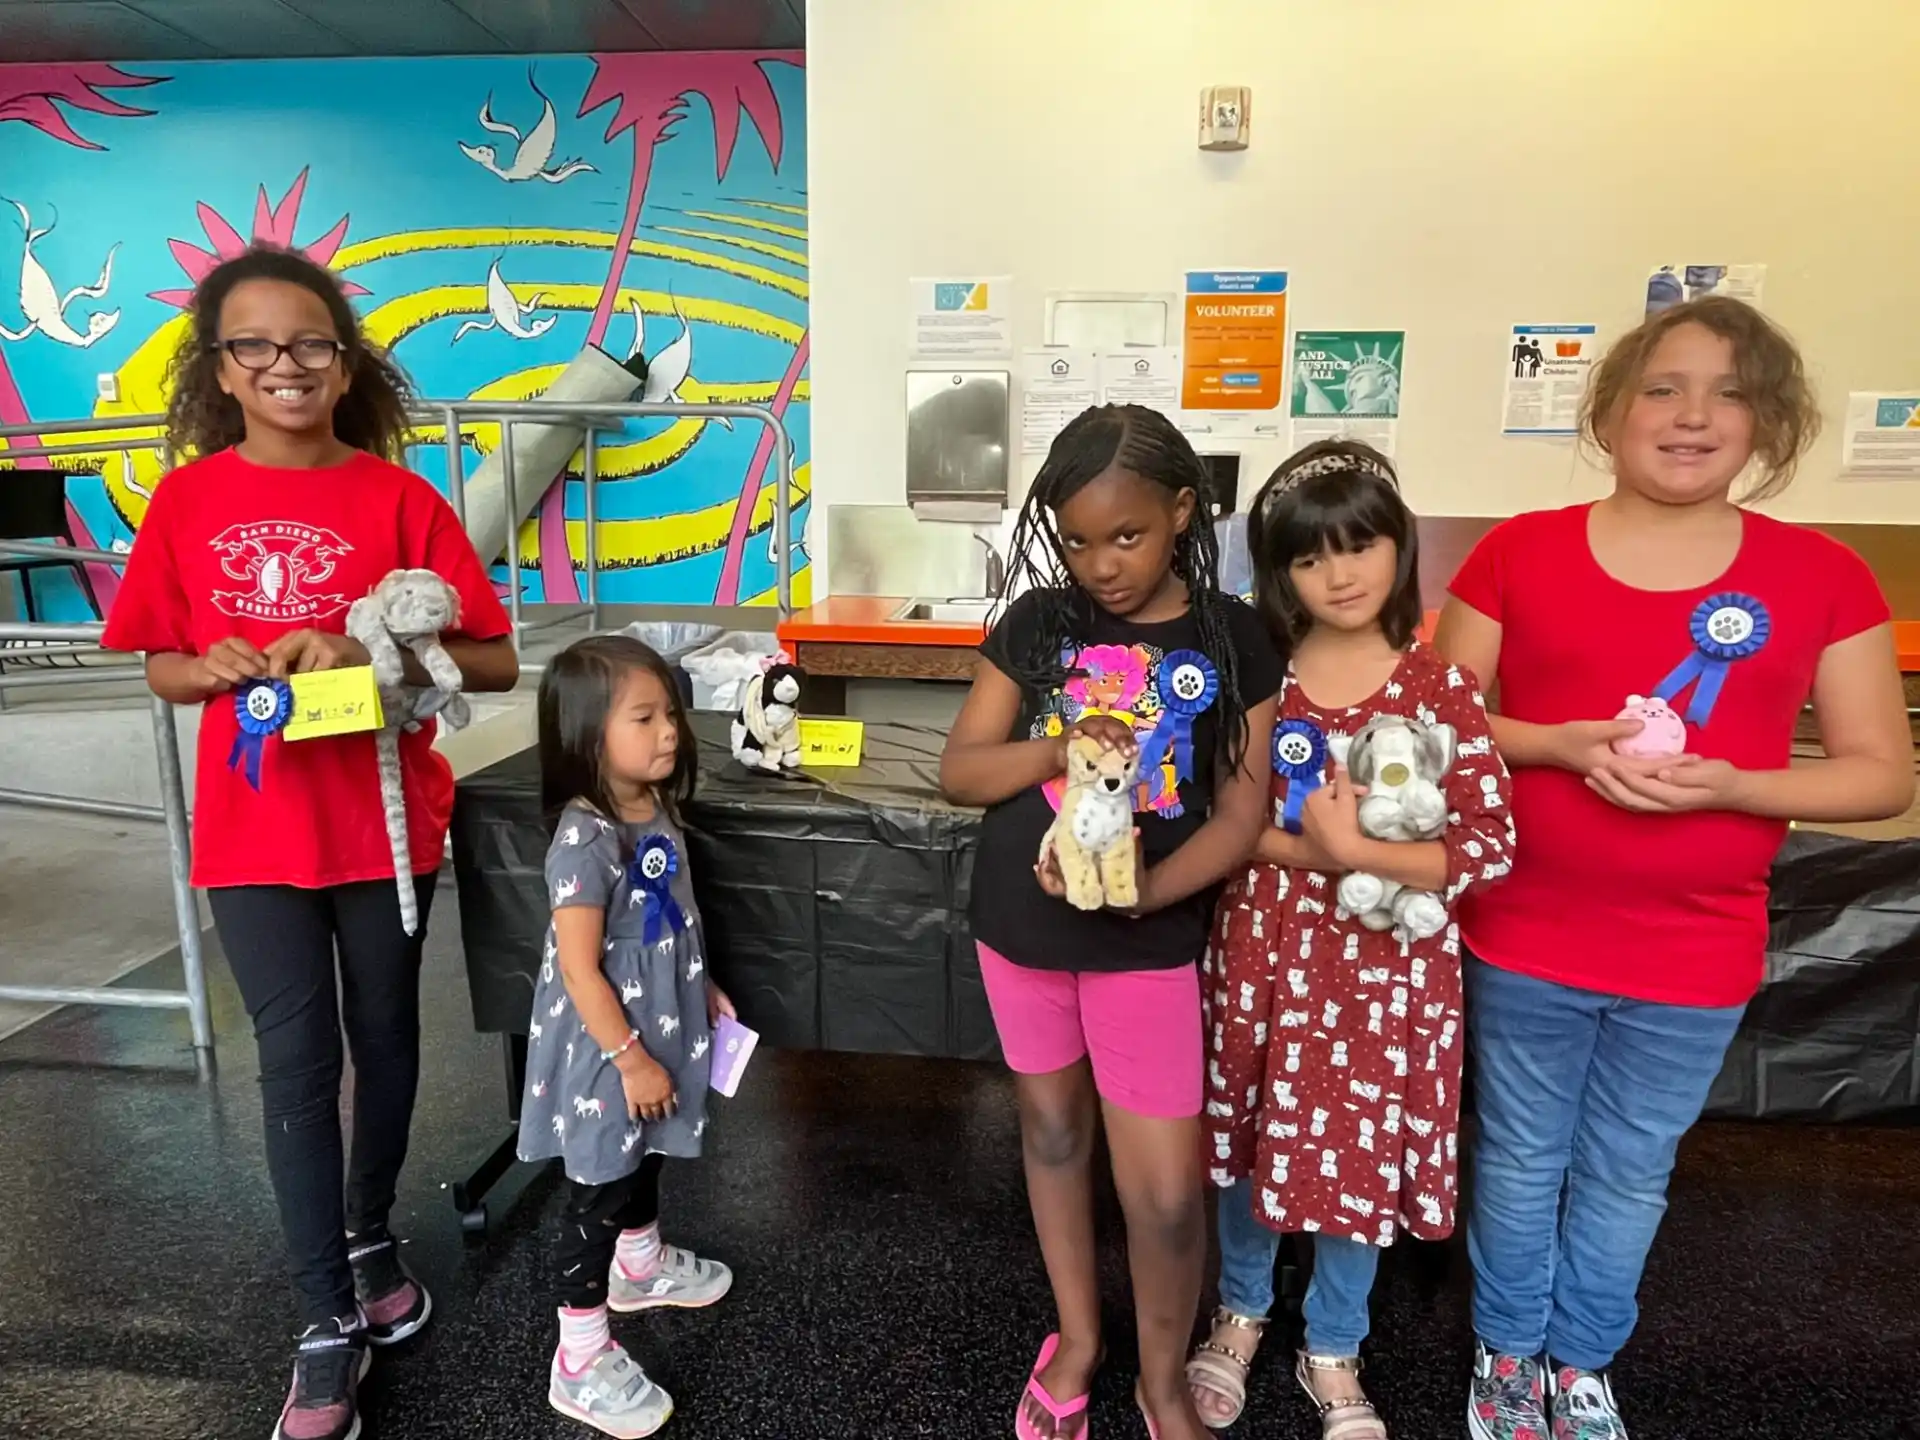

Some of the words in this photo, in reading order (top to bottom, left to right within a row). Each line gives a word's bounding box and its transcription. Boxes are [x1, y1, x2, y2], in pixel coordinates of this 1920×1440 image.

[1196, 305, 1275, 317] VOLUNTEER
[1298, 351, 1326, 360] AND
[1310, 370, 1335, 380] ALL
[240, 526, 269, 538] SAN
[275, 525, 321, 543] DIEGO
[235, 598, 318, 616] REBELLION
